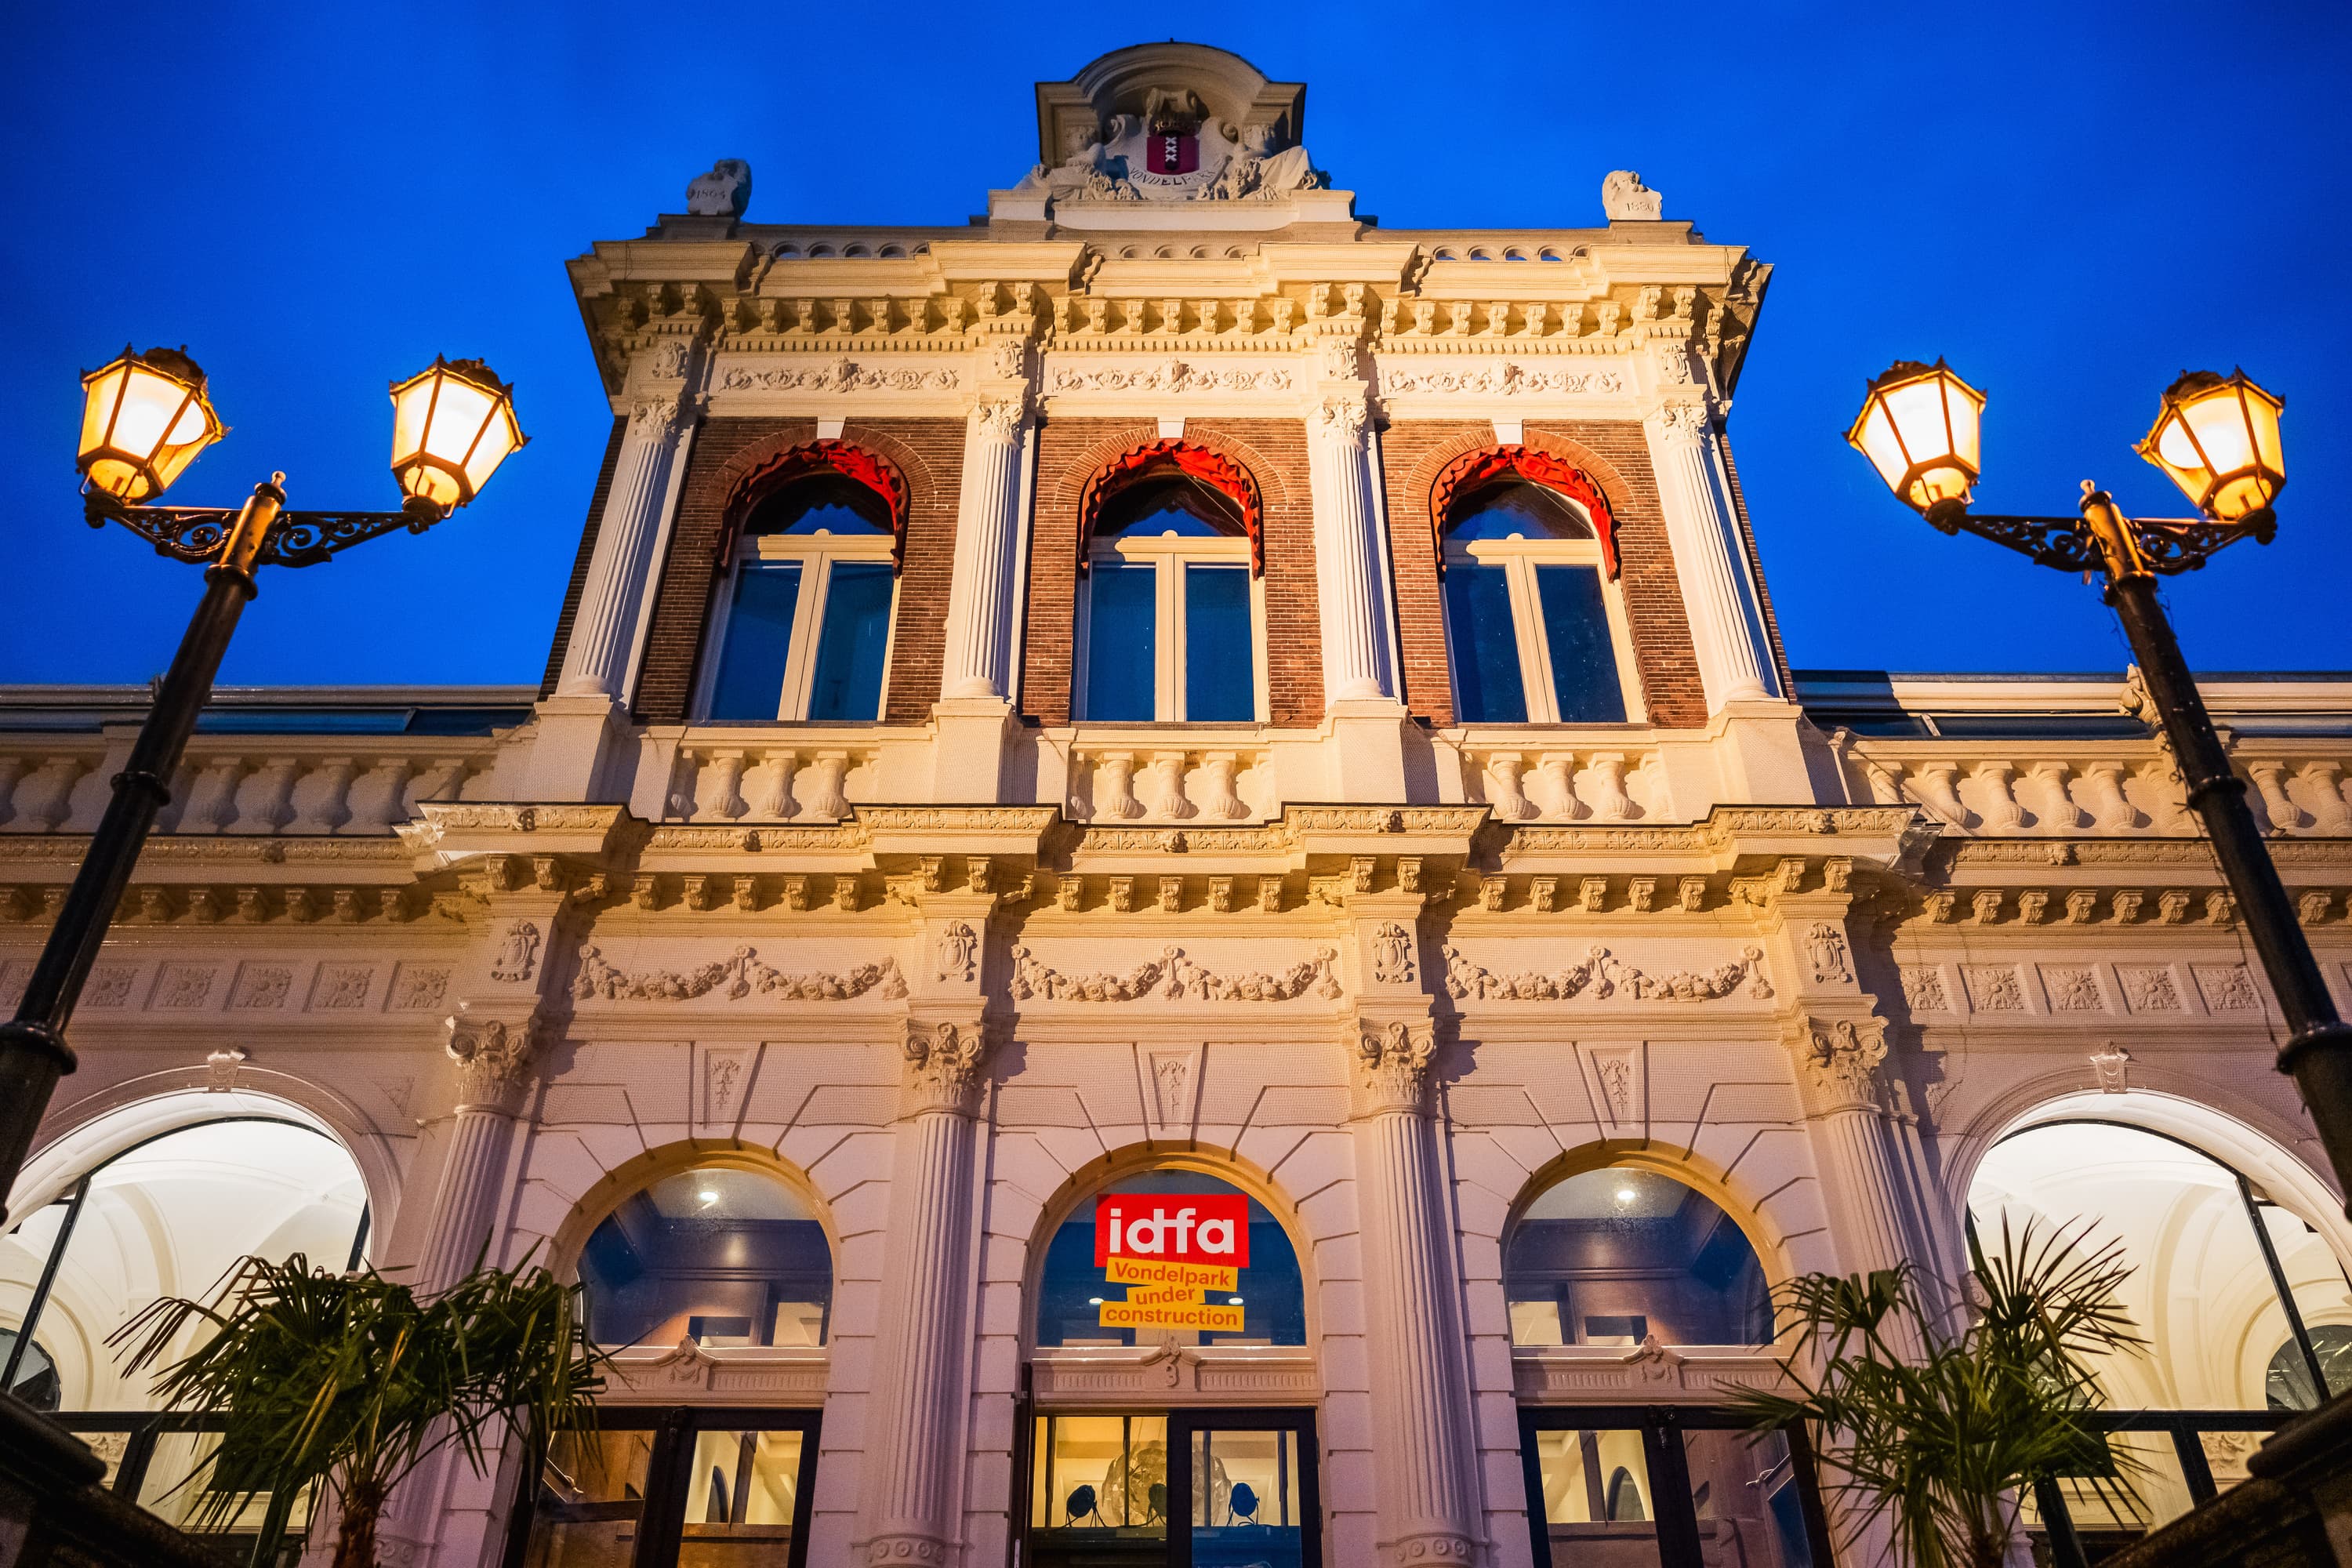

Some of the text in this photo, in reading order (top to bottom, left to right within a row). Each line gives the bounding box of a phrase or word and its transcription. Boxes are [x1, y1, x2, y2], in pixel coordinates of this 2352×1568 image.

[1109, 1208, 1235, 1254] idfa
[1114, 1261, 1230, 1287] Vondelpark
[1135, 1286, 1196, 1305] under
[1105, 1308, 1238, 1326] construction
